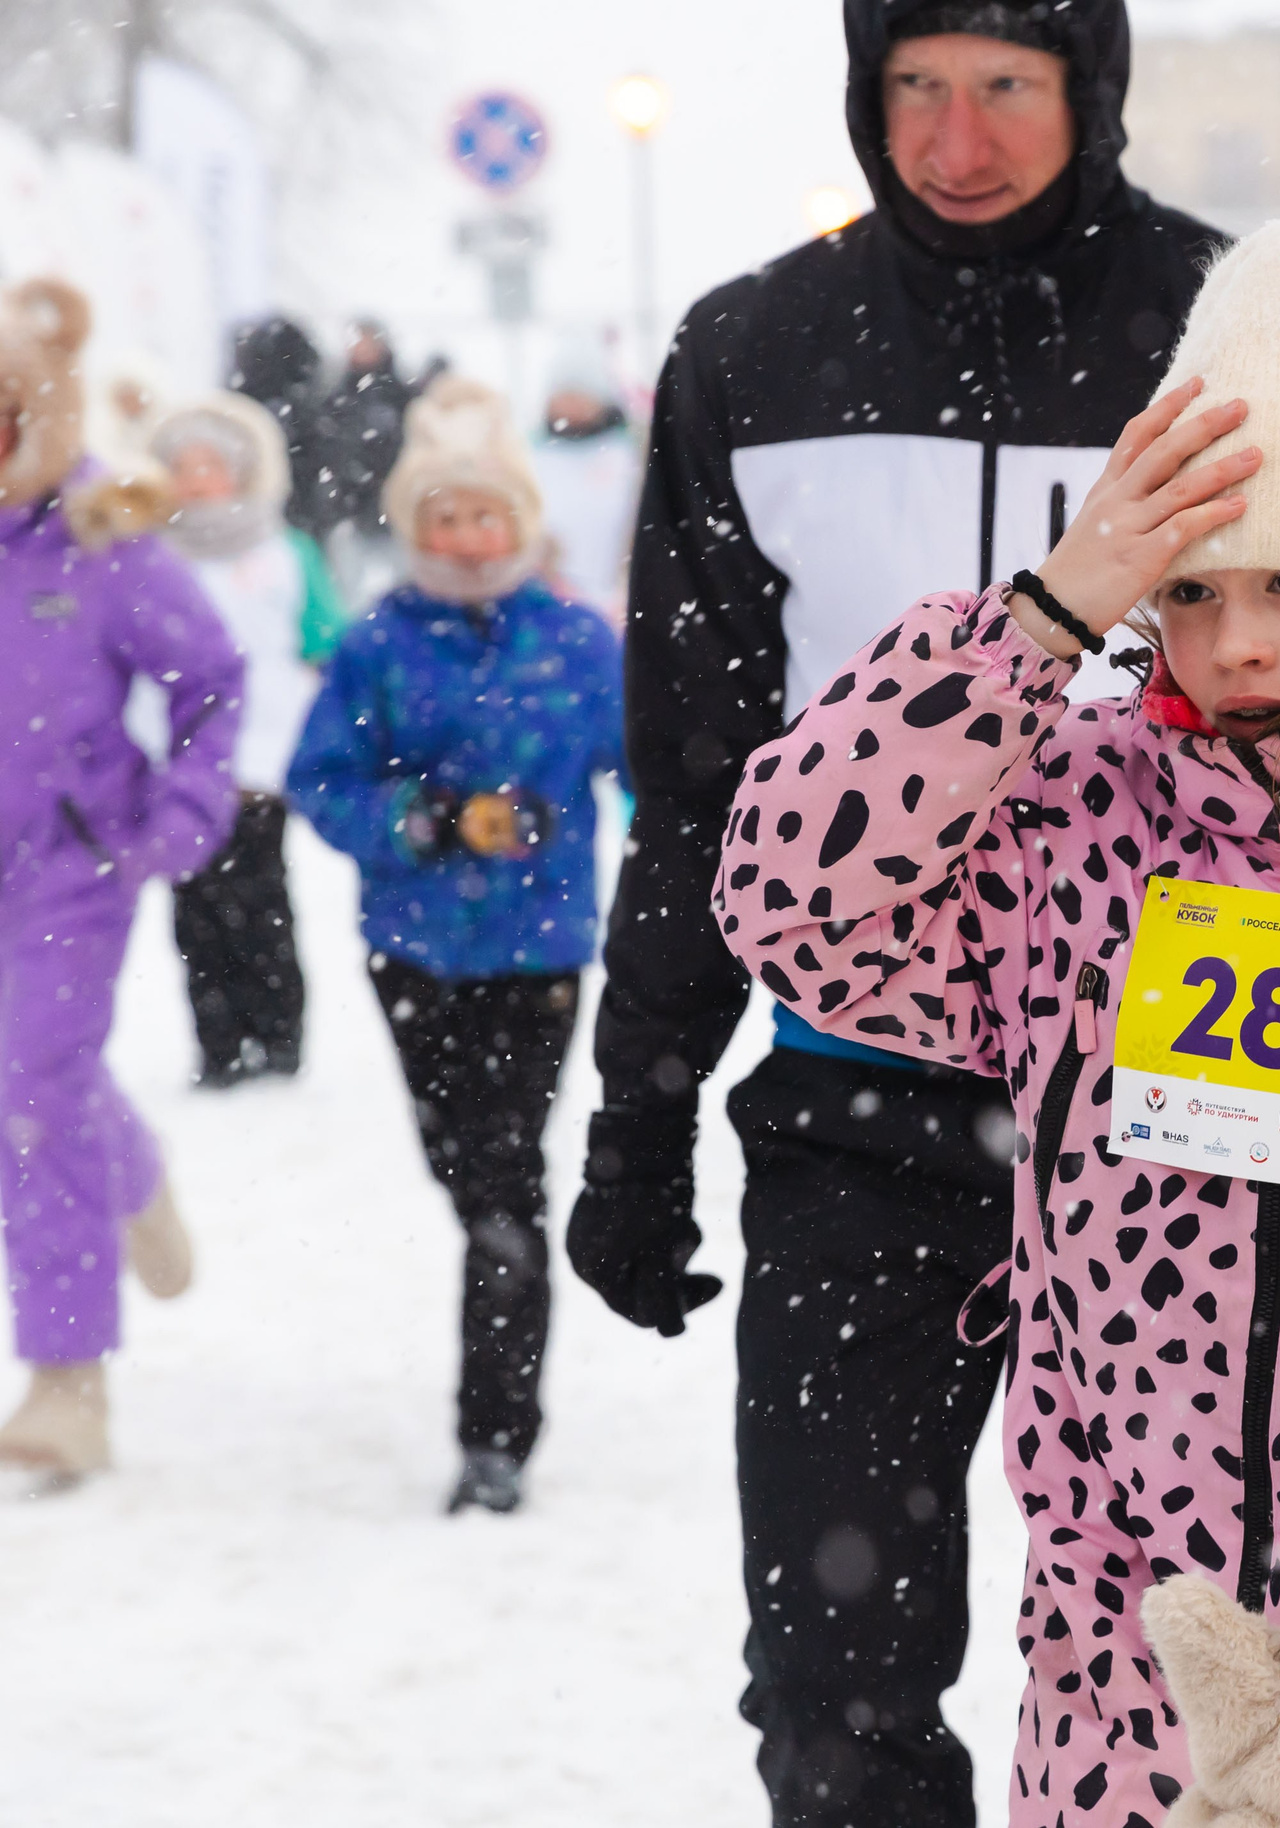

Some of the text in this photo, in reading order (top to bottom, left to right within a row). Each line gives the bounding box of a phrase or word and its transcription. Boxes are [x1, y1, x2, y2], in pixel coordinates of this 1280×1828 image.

[1179, 902, 1218, 912] ПЕЛЬМЕННЫЙ
[1177, 909, 1216, 924] КУБОК
[1205, 1102, 1246, 1113] ПУТЕШЕСТВУЙ
[1204, 1108, 1259, 1123] ПО УДМУРТИИ
[1170, 1132, 1189, 1143] HAS
